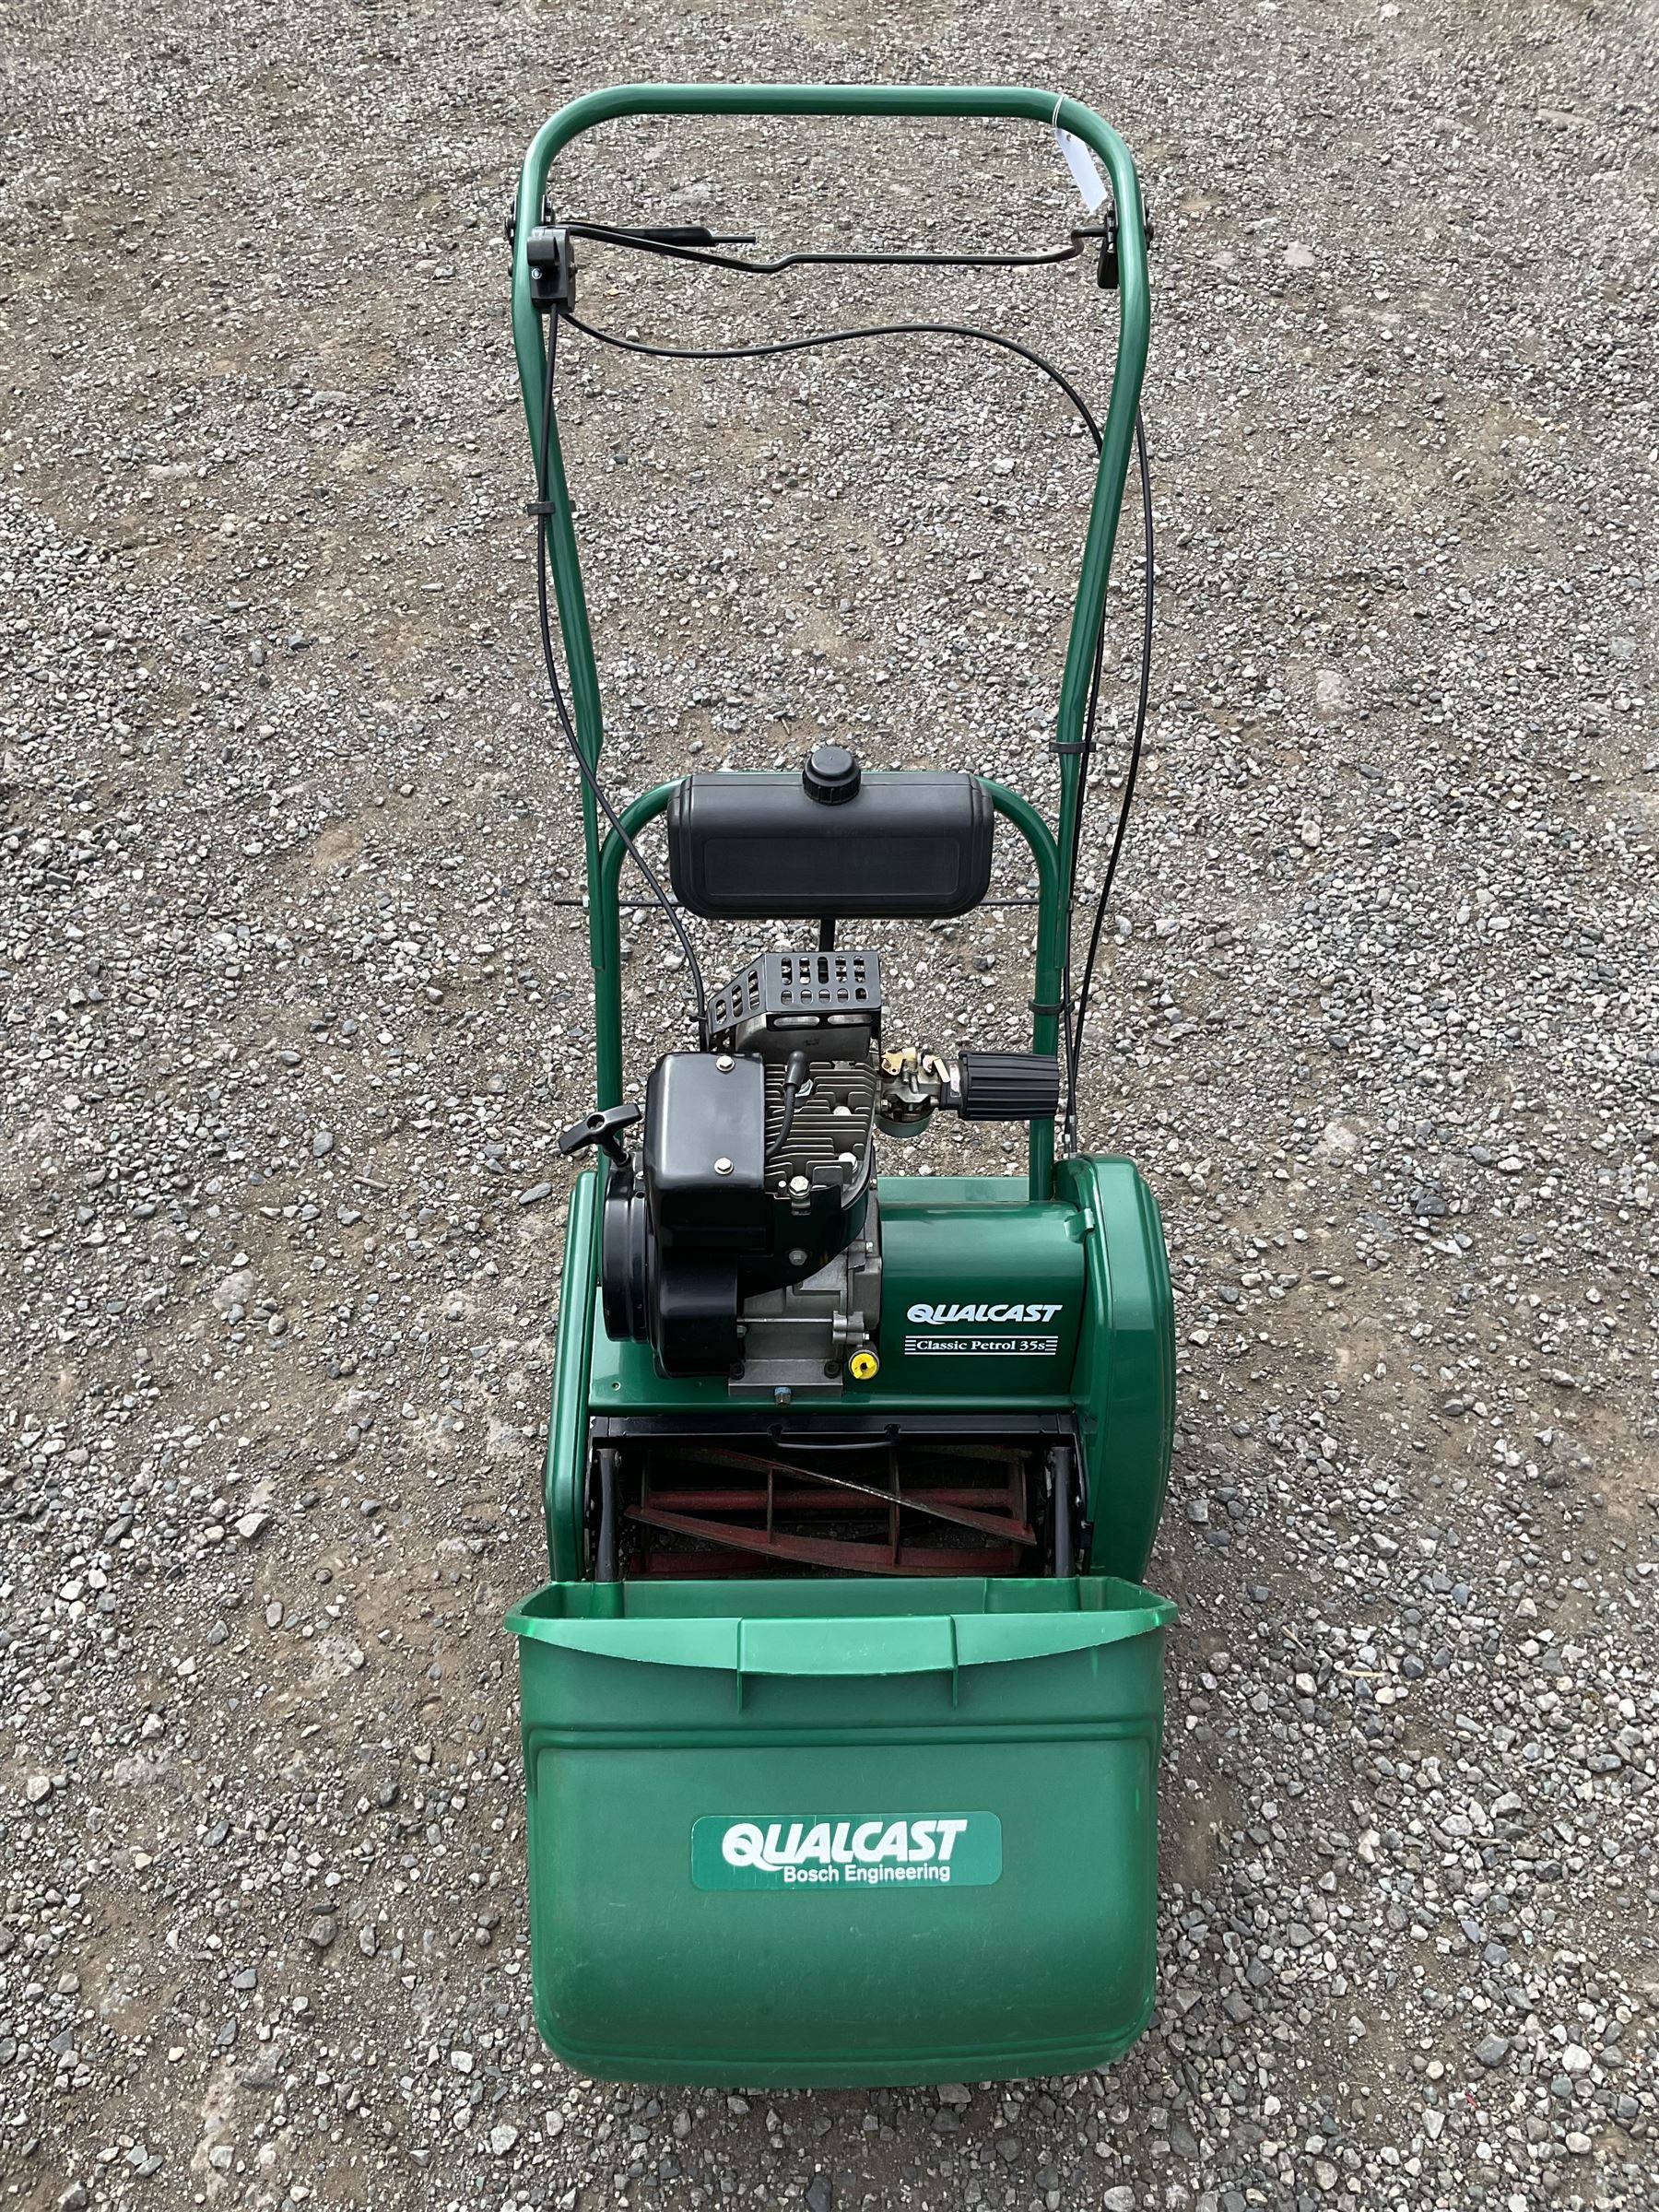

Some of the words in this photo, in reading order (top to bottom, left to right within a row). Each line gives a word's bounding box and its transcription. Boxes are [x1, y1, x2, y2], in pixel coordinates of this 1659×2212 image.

[907, 1303, 1063, 1324] QUALCAST
[916, 1340, 968, 1350] Classic
[971, 1340, 1017, 1350] Petrol
[1019, 1340, 1046, 1351] 35s
[722, 1819, 968, 1871] QUALCAST
[783, 1865, 840, 1882] Bosch
[844, 1863, 951, 1884] Engineering
